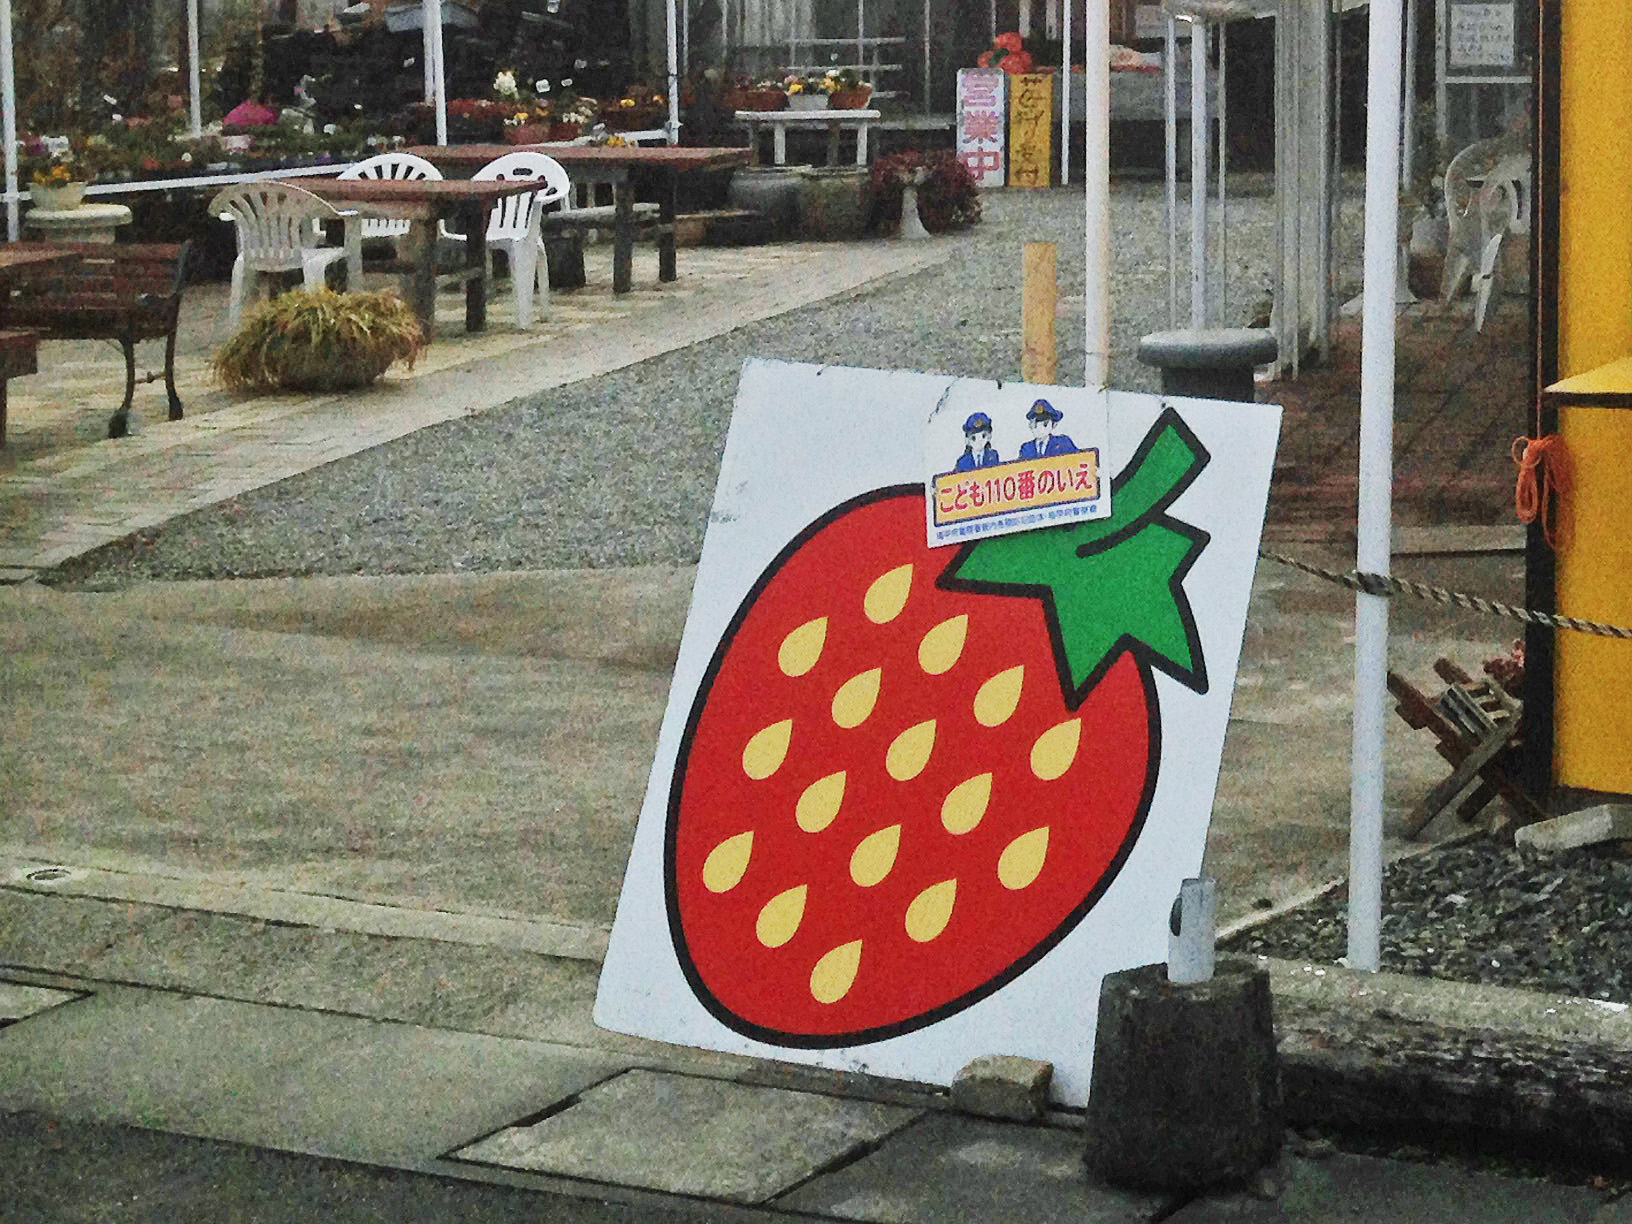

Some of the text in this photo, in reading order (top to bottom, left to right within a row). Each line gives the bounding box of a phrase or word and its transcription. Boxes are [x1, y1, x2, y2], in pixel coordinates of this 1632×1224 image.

[962, 70, 1000, 181] 営業中
[939, 462, 1094, 514] こども110番のいえ
